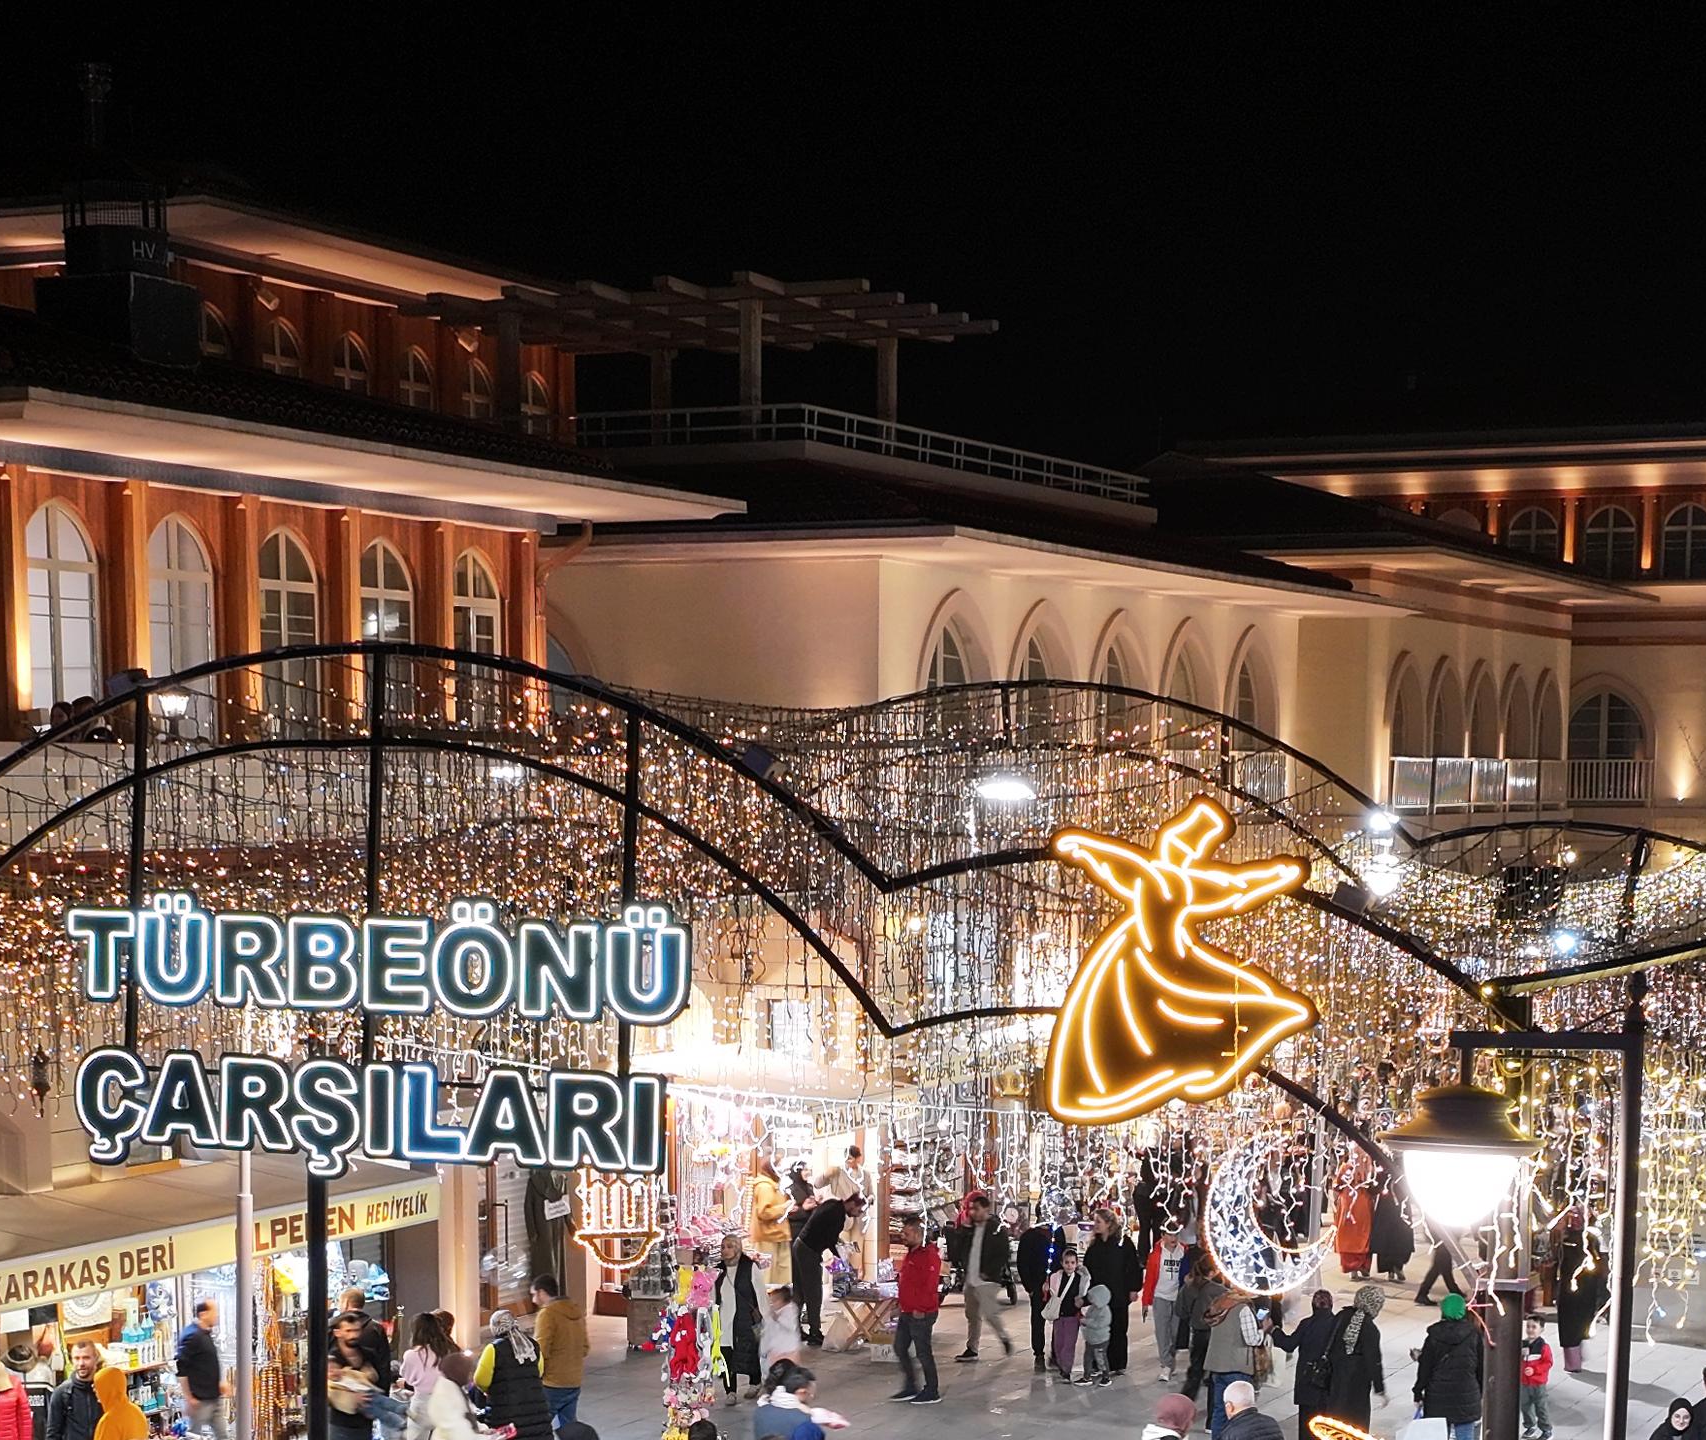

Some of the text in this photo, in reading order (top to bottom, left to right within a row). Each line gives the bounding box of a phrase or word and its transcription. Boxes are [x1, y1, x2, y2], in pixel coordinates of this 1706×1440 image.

[132, 240, 156, 259] HV
[66, 893, 691, 1024] TÜRBEÖNÜ
[74, 1047, 667, 1179] ÇARŞILARI
[235, 1190, 429, 1252] LPEEN HEDİYELİK
[119, 1236, 175, 1280] DERİ
